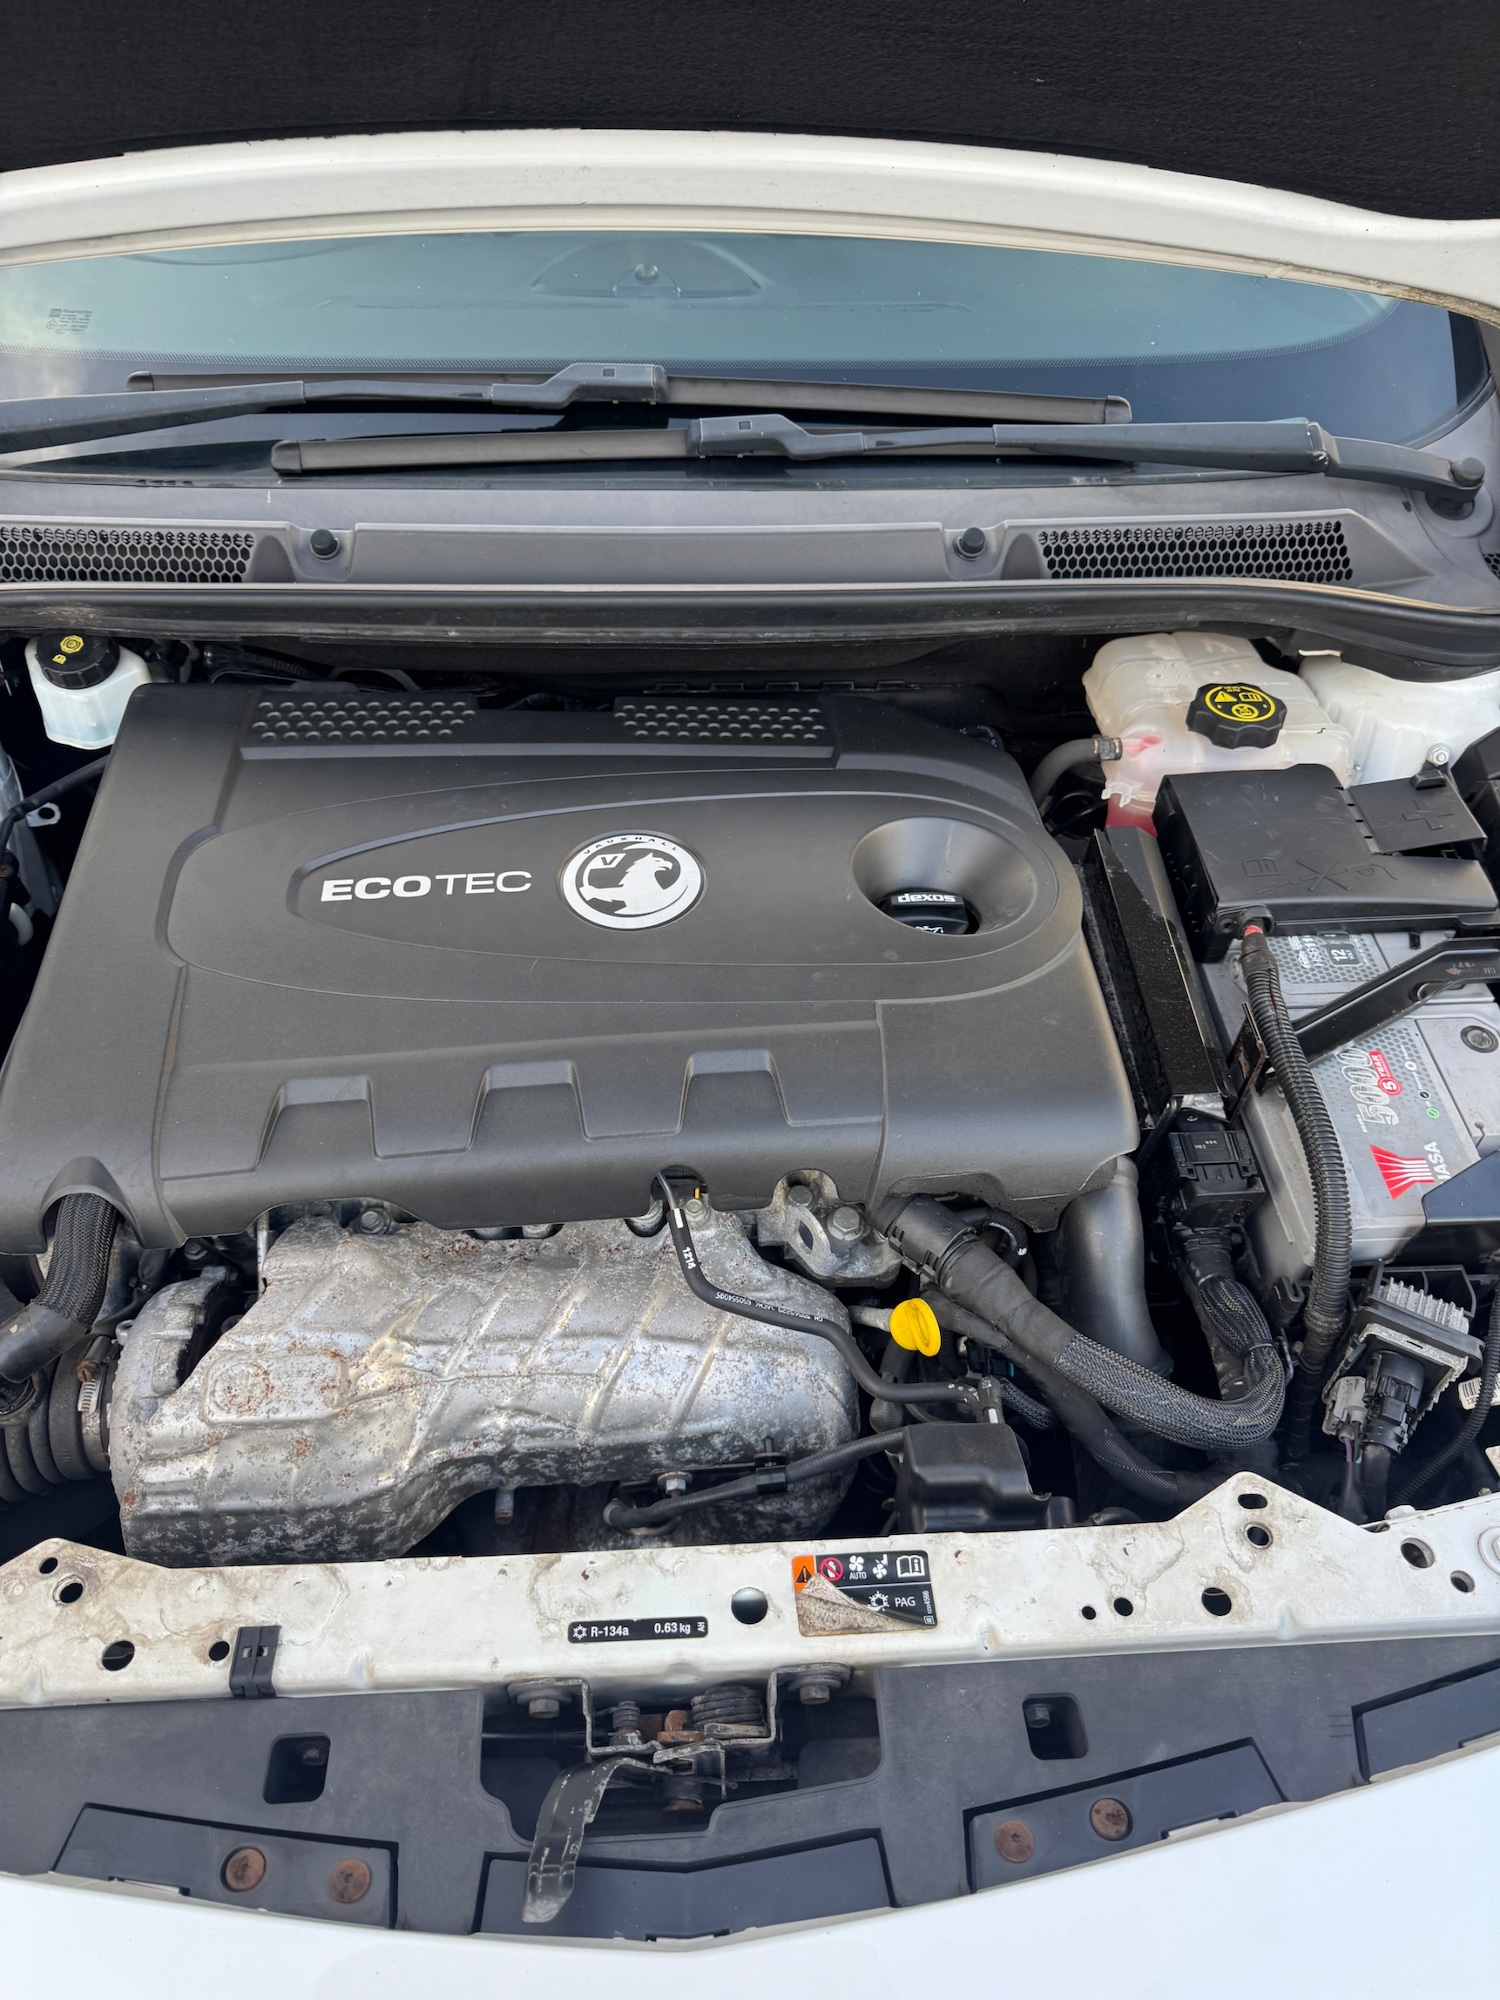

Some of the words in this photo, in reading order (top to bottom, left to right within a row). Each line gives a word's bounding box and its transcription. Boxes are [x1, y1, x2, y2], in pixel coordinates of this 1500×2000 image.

[320, 871, 532, 902] ECOTEC
[898, 893, 956, 903] dexos
[1331, 949, 1348, 961] 12
[1335, 1047, 1399, 1125] 5000
[1382, 1081, 1398, 1091] 5
[849, 1572, 867, 1580] AUTO
[894, 1596, 916, 1608] PAG
[590, 1626, 629, 1638] R-134a
[654, 1622, 678, 1634] 0.63
[679, 1623, 691, 1635] kg
